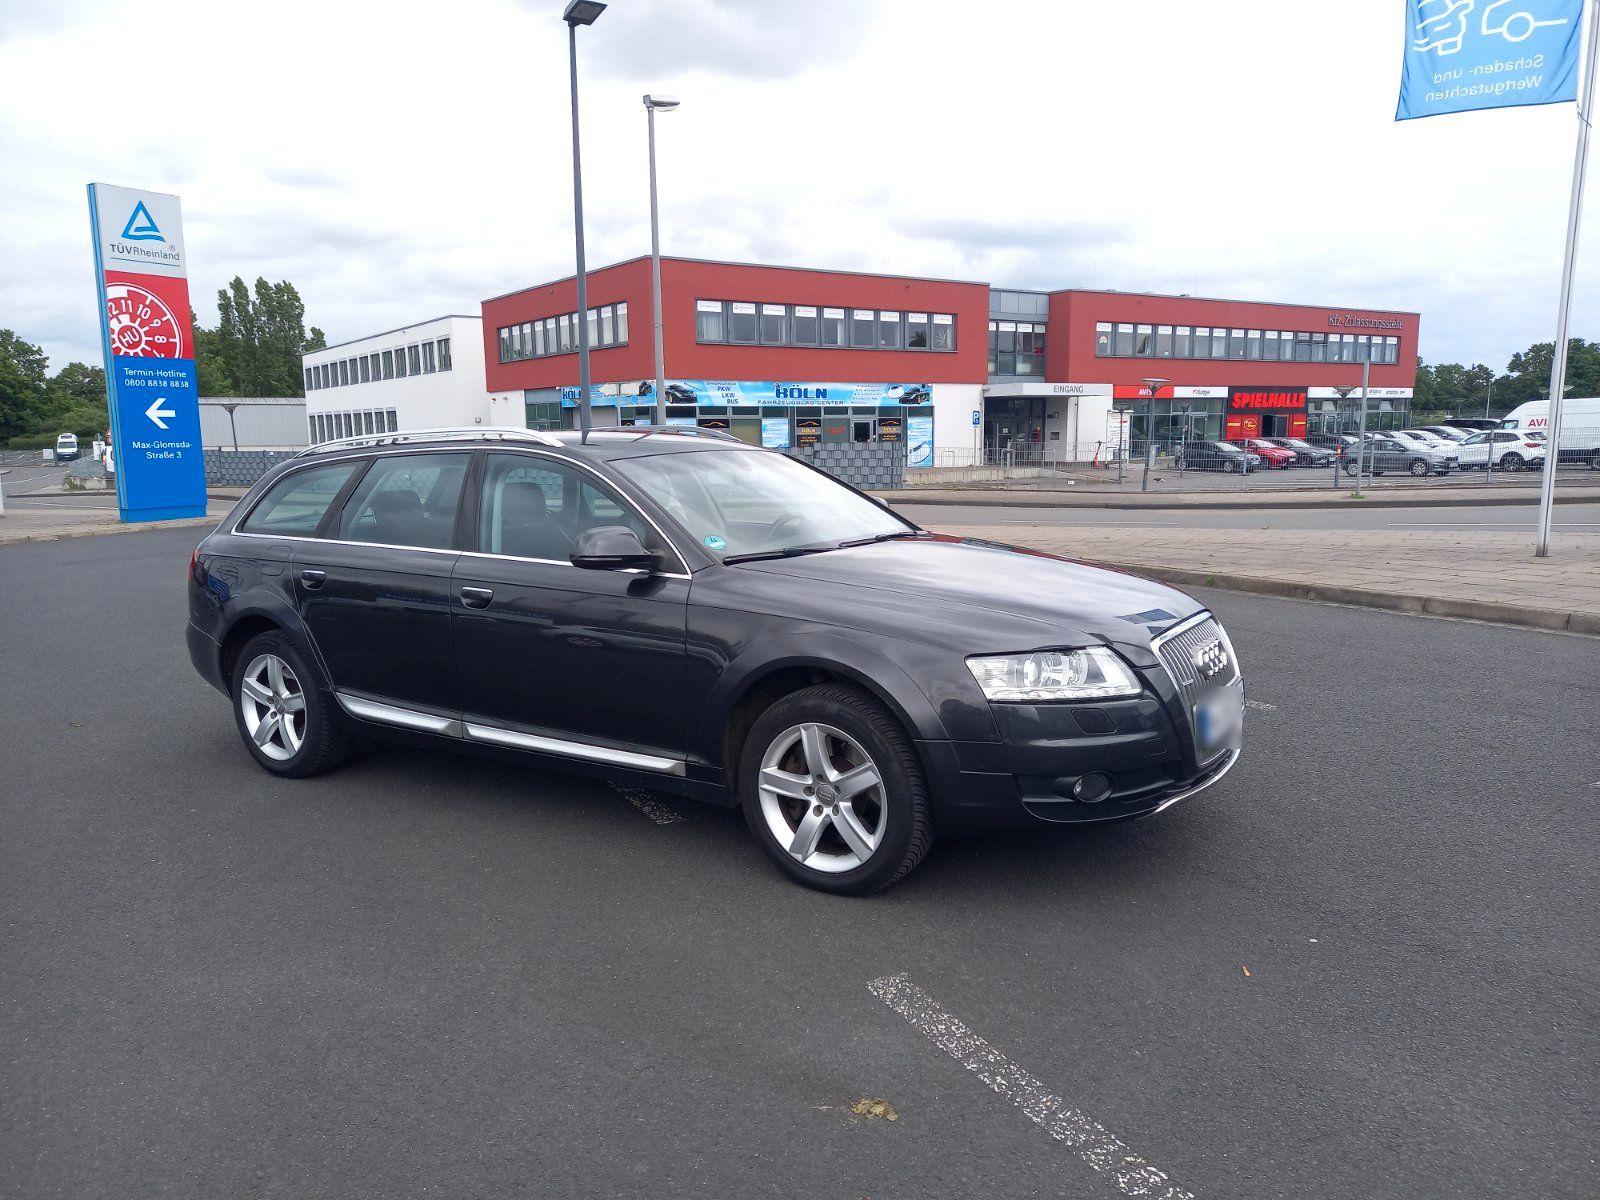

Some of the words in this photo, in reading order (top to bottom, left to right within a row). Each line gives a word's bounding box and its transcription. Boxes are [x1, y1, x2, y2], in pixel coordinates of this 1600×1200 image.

[107, 302, 120, 317] 2
[120, 299, 133, 313] 11
[136, 303, 151, 319] 10
[119, 328, 140, 347] HU
[154, 335, 167, 343] 8
[123, 367, 187, 378] Termin-Hotline
[124, 378, 146, 387] 0800
[147, 379, 168, 388] 8838
[170, 380, 190, 388] 8838
[775, 383, 828, 399] KÖLN
[1053, 385, 1084, 393] EINGANG
[1231, 392, 1306, 408] SPIELHALLE
[1528, 418, 1550, 428] AVI
[132, 440, 193, 449] Max-Glomsda-
[146, 451, 174, 460] Straße
[176, 451, 182, 459] 3
